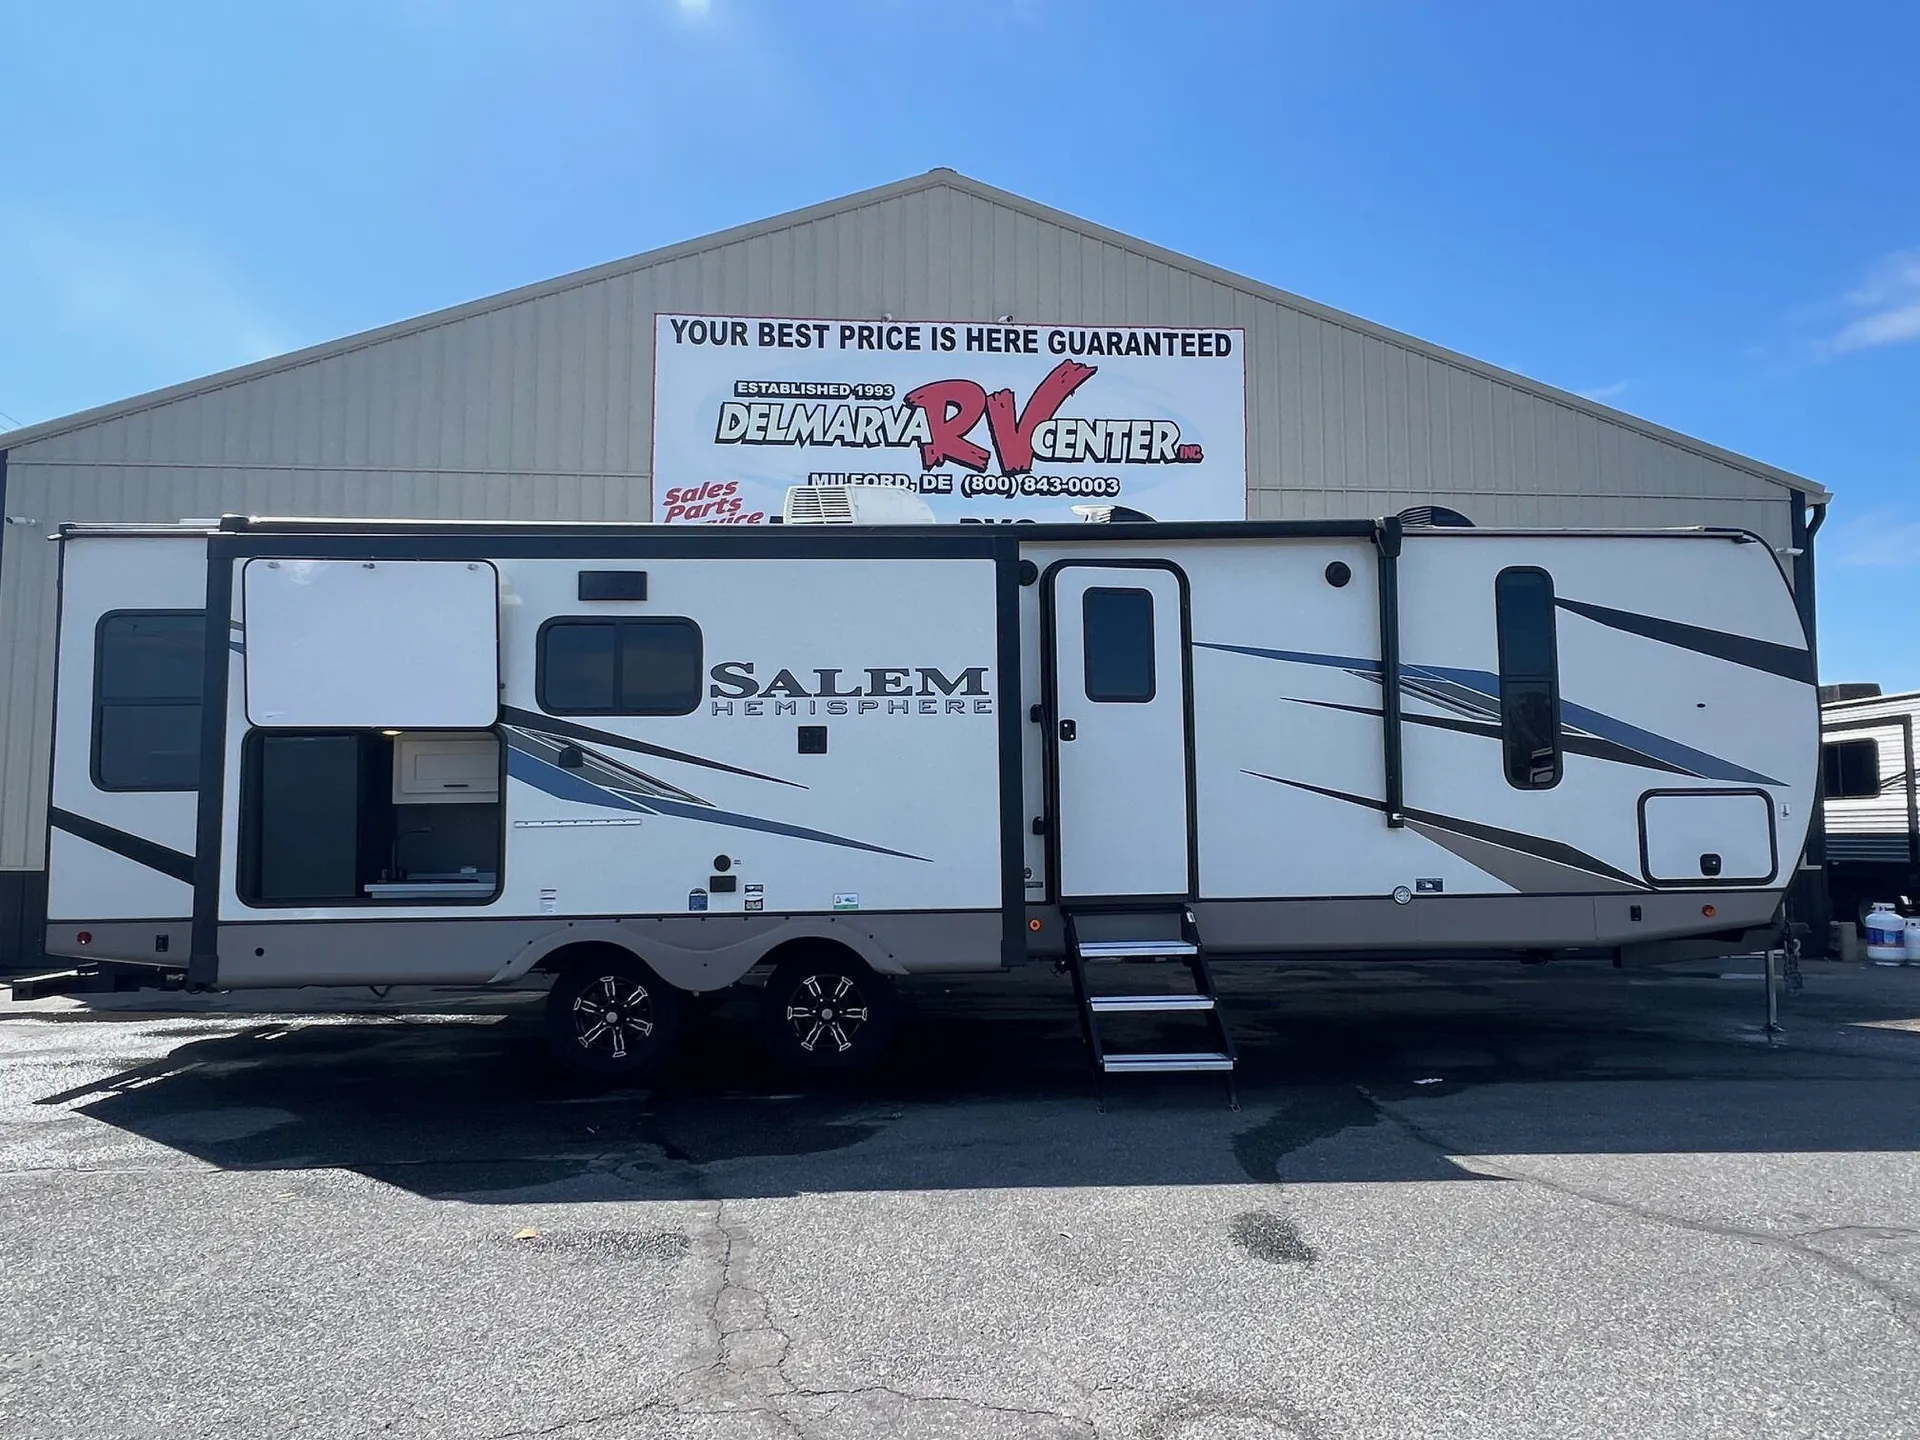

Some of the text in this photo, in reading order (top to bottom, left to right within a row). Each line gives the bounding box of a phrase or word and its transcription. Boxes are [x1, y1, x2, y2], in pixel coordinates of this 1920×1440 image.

[670, 318, 1232, 357] YOUR BEST PRICE IS HERE GUARANTEED
[735, 381, 895, 399] ESTABLISHED 1993
[715, 402, 933, 448] DELMARVA
[903, 358, 1098, 475] RV
[1030, 419, 1180, 464] CENTER
[663, 480, 739, 506] Sales
[919, 474, 953, 494] DE
[961, 474, 1018, 498] (800)
[1020, 476, 1120, 497] 843-0003
[664, 497, 743, 523] Parts
[710, 661, 990, 698] SALEM
[711, 699, 993, 716] HEMISPHERE
